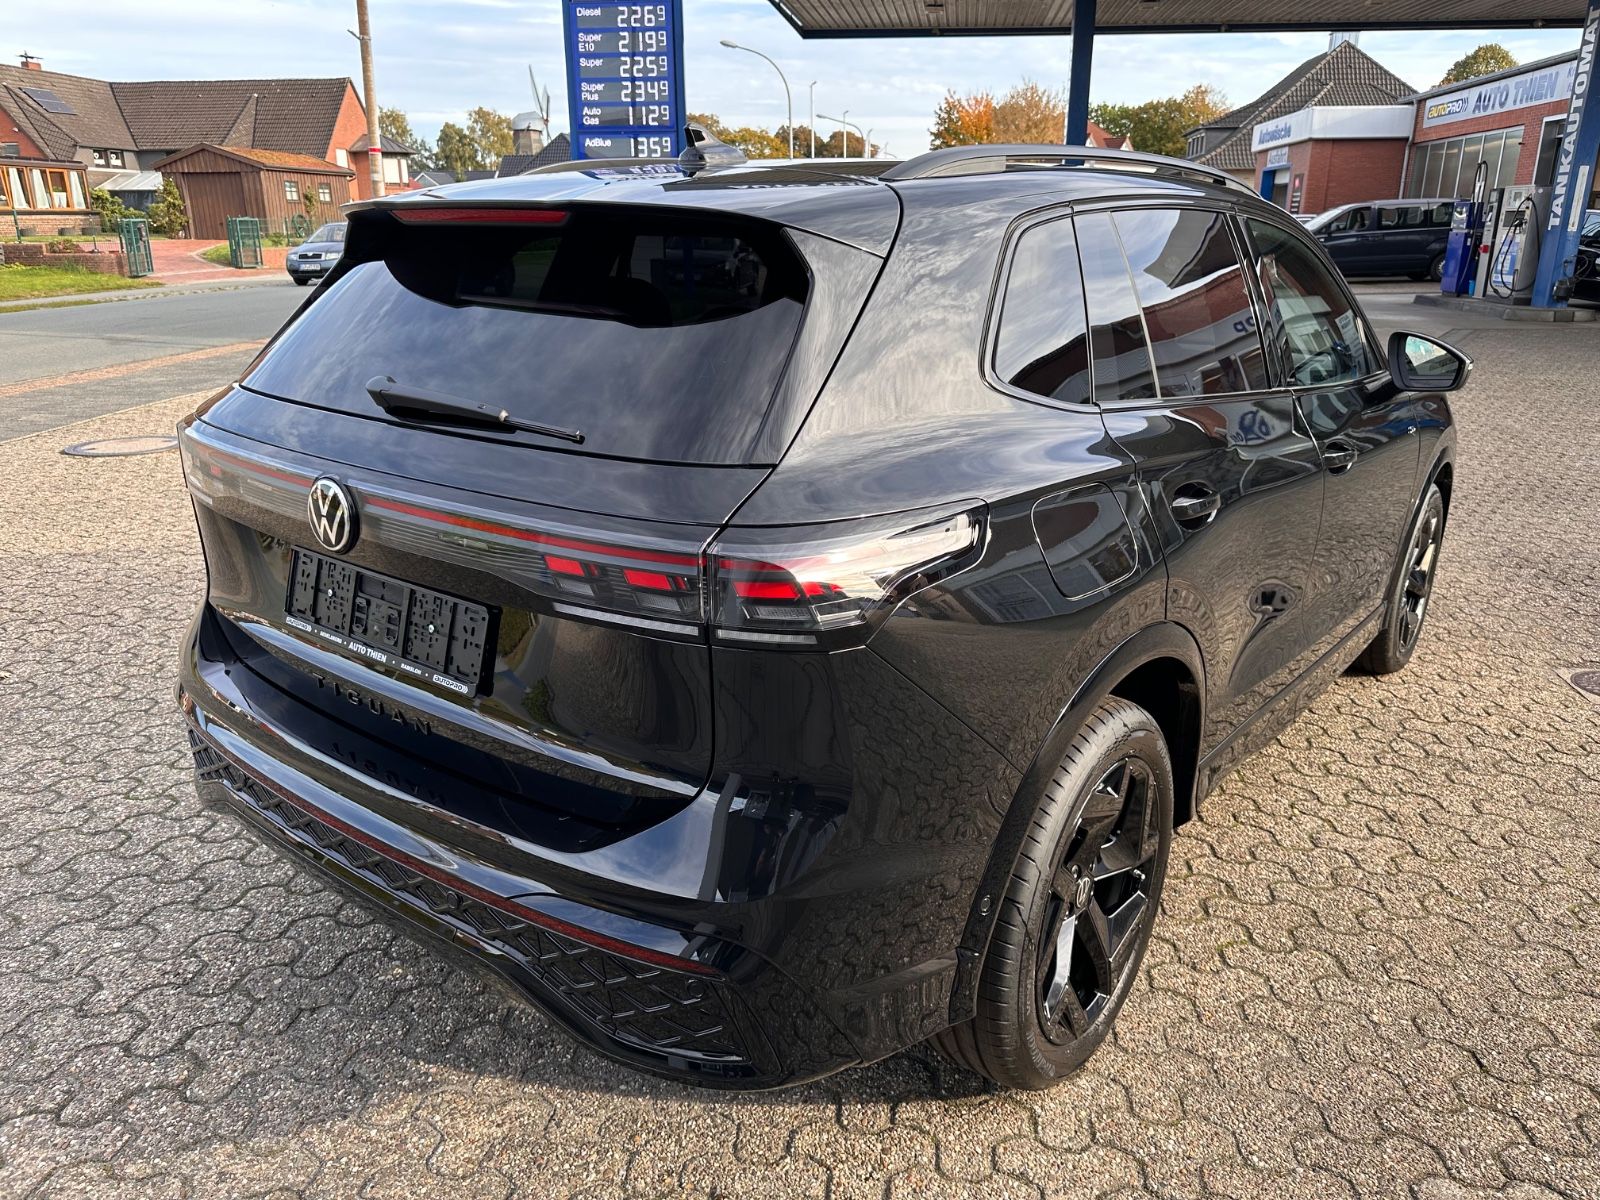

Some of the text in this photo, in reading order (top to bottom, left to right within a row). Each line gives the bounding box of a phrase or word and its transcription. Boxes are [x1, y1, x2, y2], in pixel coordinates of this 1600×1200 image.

[576, 7, 601, 17] Diesel
[578, 33, 602, 44] Super
[578, 43, 595, 52] E10
[579, 58, 603, 67] Super
[581, 83, 605, 92] Super
[1472, 83, 1509, 114] AUTO
[1513, 71, 1559, 106] THIEN
[581, 92, 599, 101] Plus
[582, 106, 601, 116] Auto
[583, 116, 600, 126] Gas
[1548, 6, 1600, 231] TANKAUTOMAT
[584, 138, 612, 148] AdBlue
[348, 641, 366, 655] AUTO
[366, 648, 387, 663] THIEN
[313, 673, 431, 735] TIGUAN
